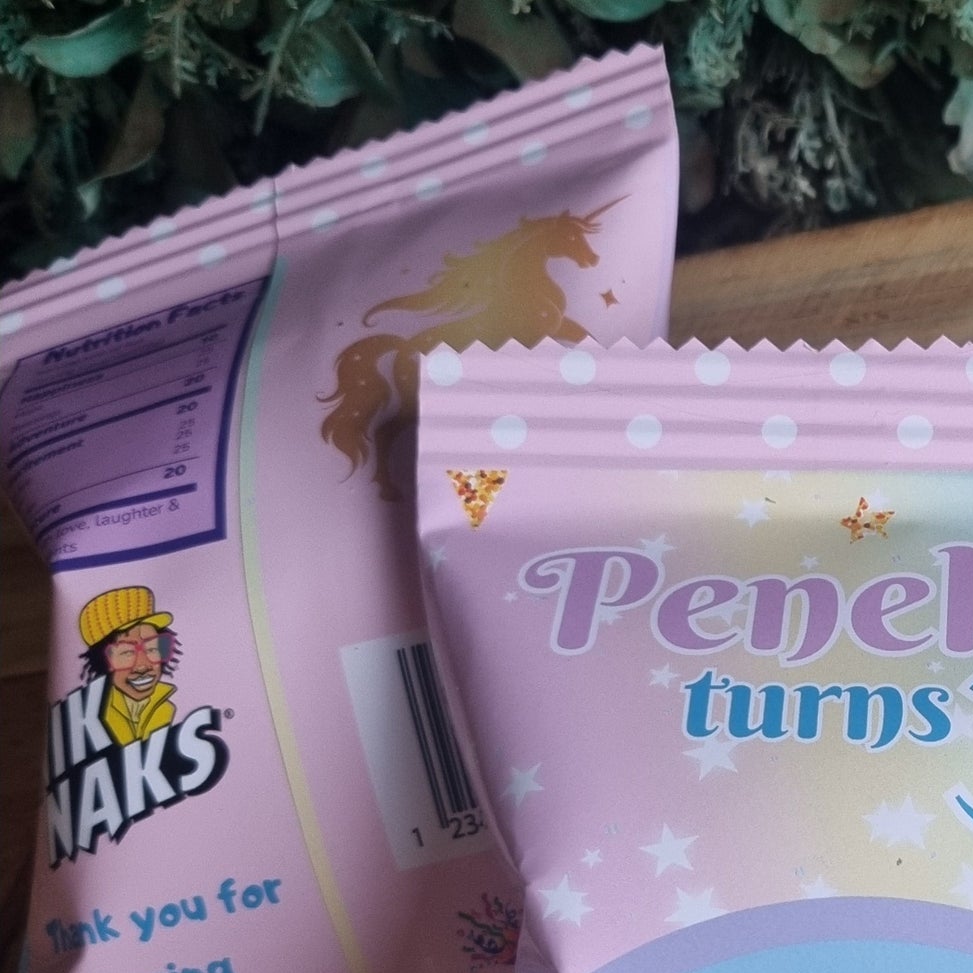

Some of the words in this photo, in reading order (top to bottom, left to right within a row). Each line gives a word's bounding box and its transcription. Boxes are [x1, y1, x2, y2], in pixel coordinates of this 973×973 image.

[44, 319, 161, 365] Nutrition
[168, 291, 246, 324] Facts
[163, 464, 187, 479] 20
[95, 504, 164, 526] laughter
[168, 498, 180, 511] &
[50, 673, 116, 784] IK
[685, 669, 952, 749] turns
[412, 827, 424, 847] 1
[130, 896, 208, 942] you
[217, 878, 282, 913] for
